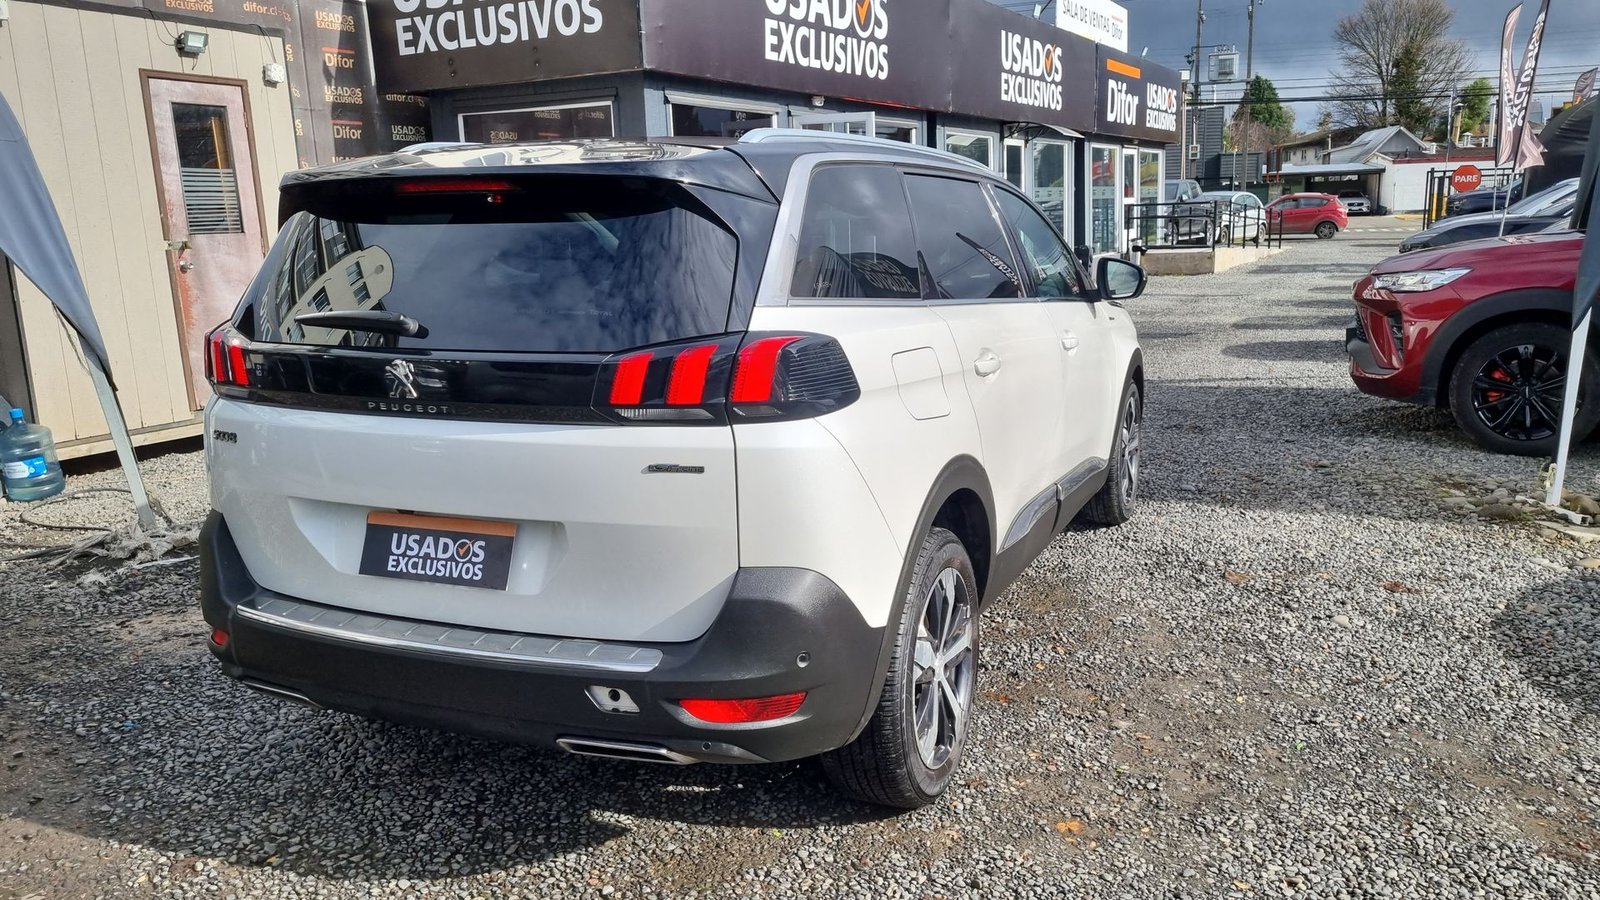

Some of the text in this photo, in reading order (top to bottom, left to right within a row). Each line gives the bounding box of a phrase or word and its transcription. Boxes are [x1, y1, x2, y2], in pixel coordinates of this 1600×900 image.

[315, 10, 354, 25] USADOS
[316, 21, 355, 33] EXCLUSIVOS
[395, 0, 603, 56] EXCLUSIVOS
[1063, 0, 1078, 20] SALA
[1080, 6, 1088, 24] DE
[1089, 9, 1109, 33] VENTAS
[765, 18, 888, 80] EXCLUSIVOS
[1001, 30, 1062, 82] USADOS
[325, 53, 355, 69] Difor
[324, 85, 362, 98] USADOS
[325, 94, 363, 105] EXCLUSIVOS
[1001, 72, 1062, 111] EXCLUSIVOS
[1106, 79, 1139, 126] Difor
[1146, 82, 1177, 113] USADOS
[391, 124, 426, 136] USADOS
[1146, 109, 1177, 132] EXCLUSIVOS
[333, 125, 362, 140] Difor
[1454, 175, 1479, 183] PARE
[368, 401, 449, 414] PEUGEOT
[390, 532, 486, 562] USADOS
[387, 555, 484, 581] EXCLUSIVOS
